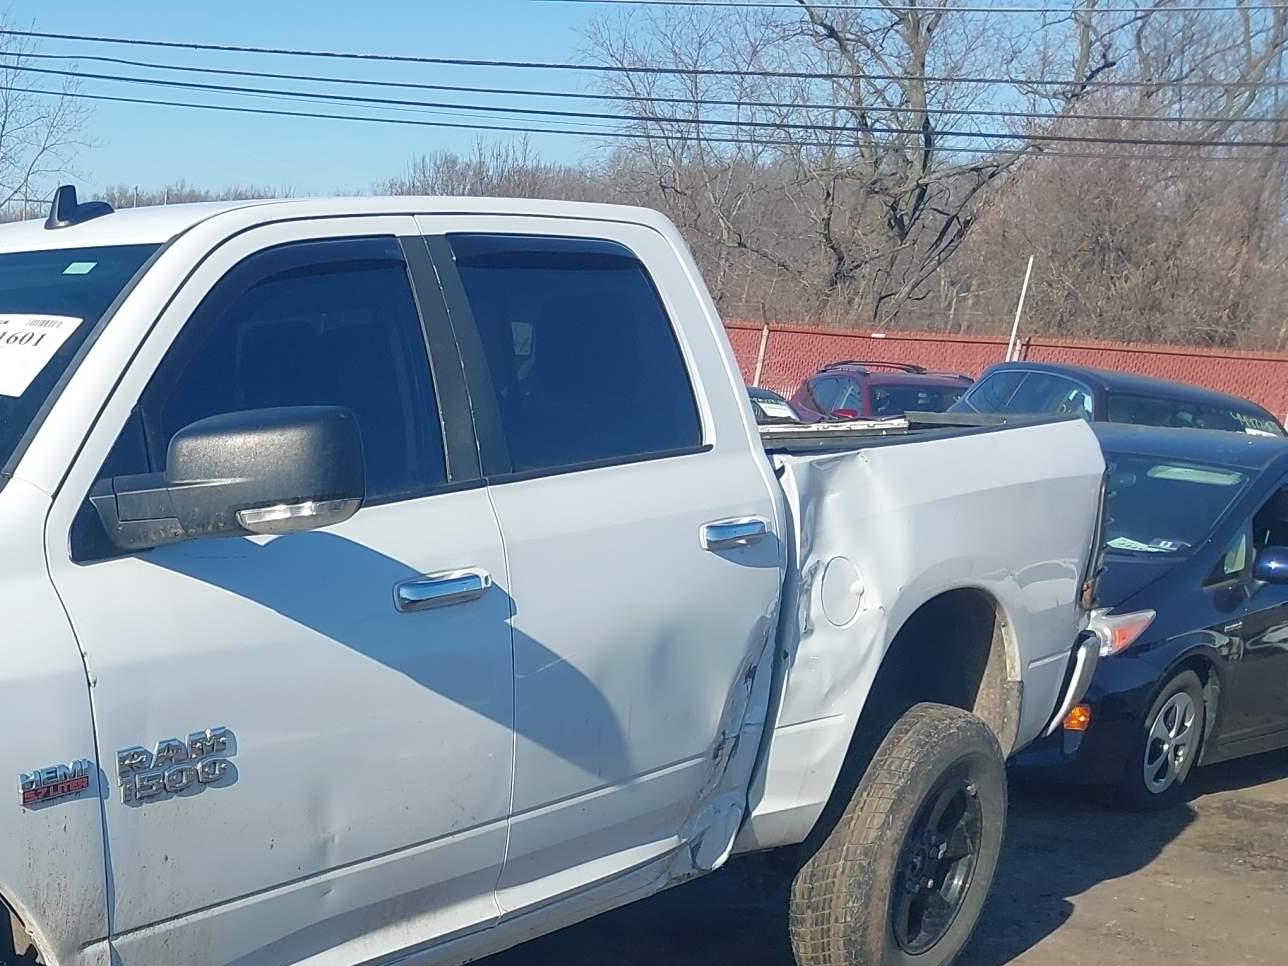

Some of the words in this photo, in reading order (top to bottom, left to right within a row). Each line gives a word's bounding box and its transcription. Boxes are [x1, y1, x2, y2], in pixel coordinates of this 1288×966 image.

[114, 726, 227, 776] RAM
[16, 758, 88, 790] HEMI
[50, 778, 87, 797] LITER
[117, 757, 228, 805] 1500
